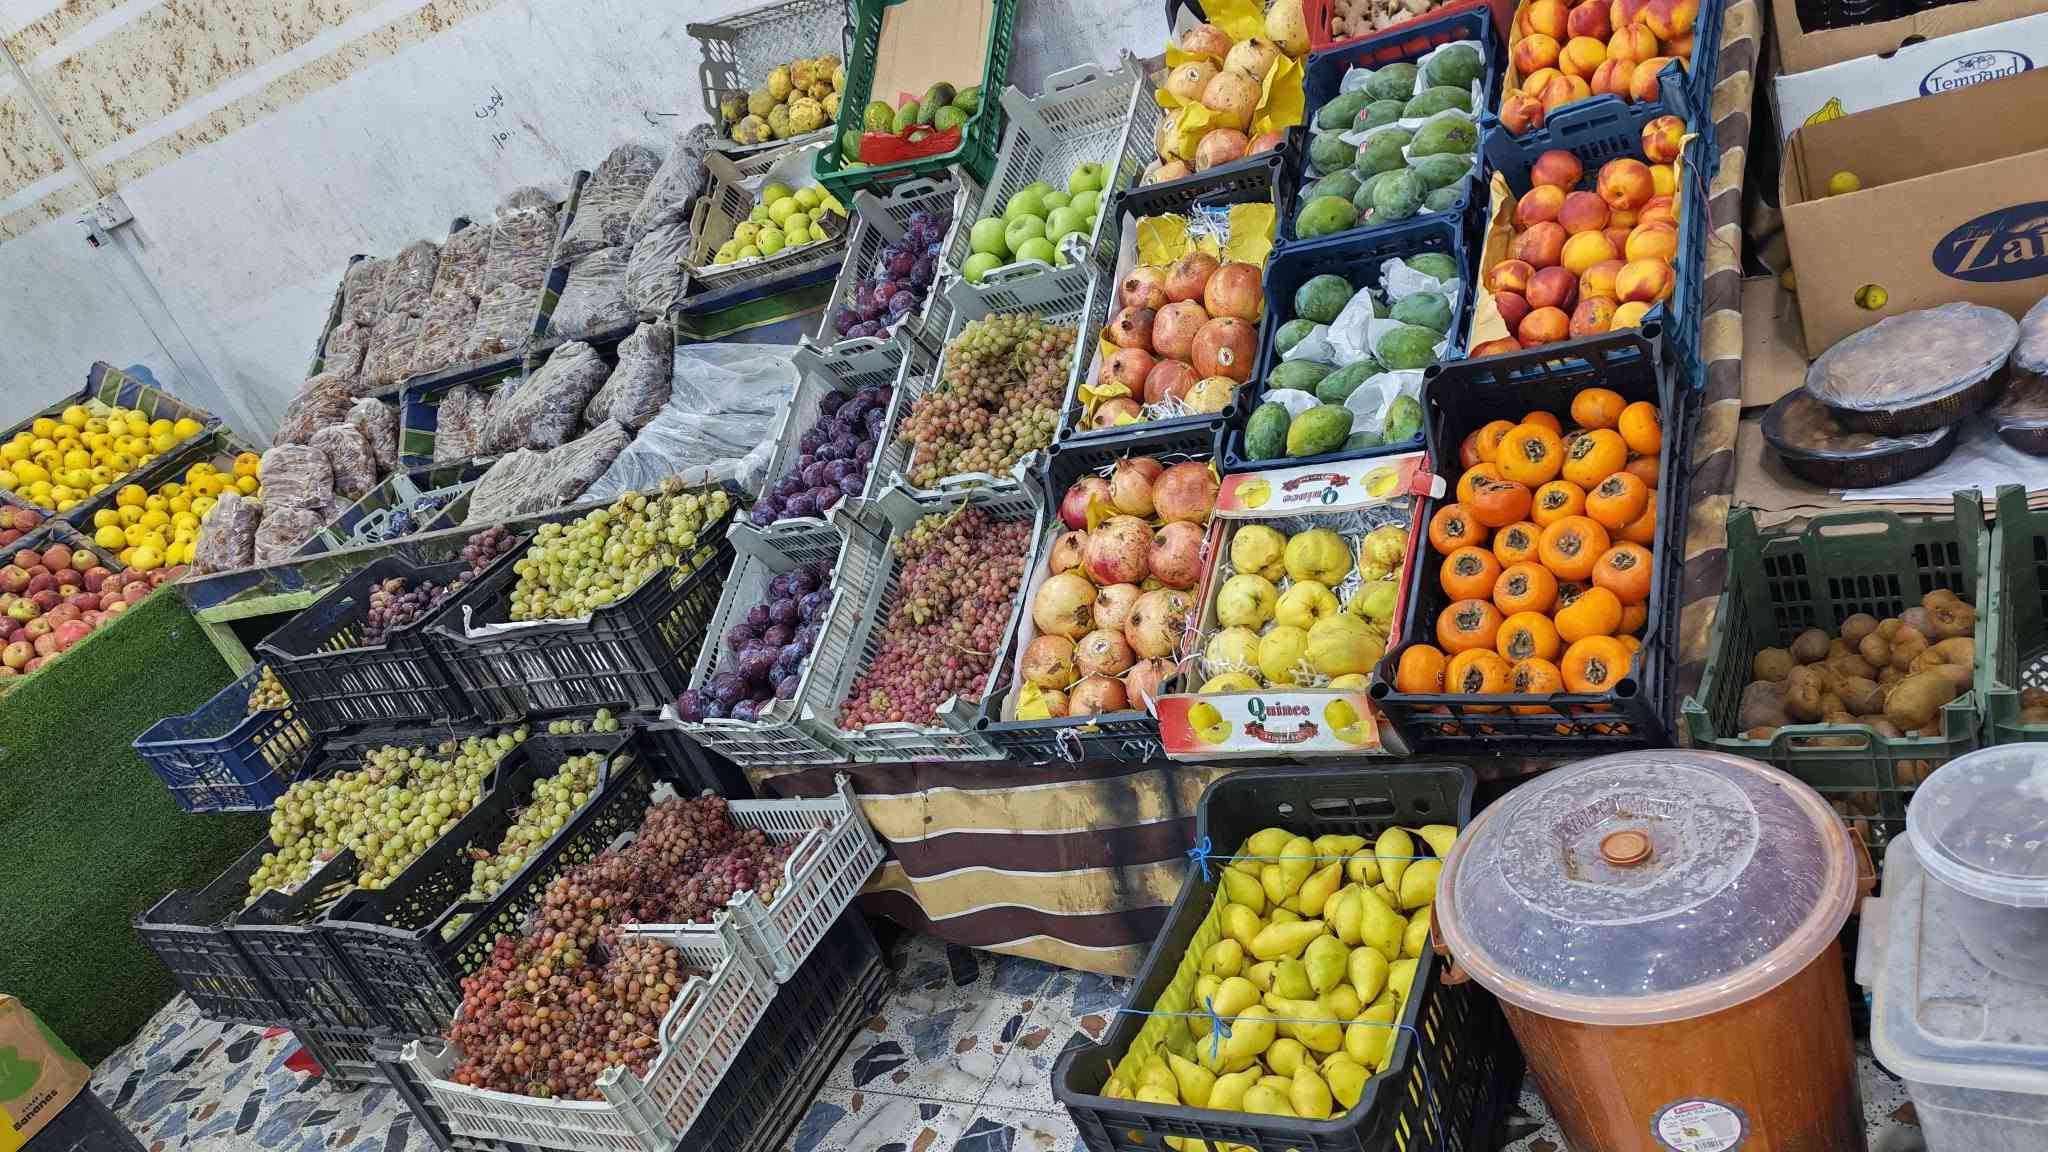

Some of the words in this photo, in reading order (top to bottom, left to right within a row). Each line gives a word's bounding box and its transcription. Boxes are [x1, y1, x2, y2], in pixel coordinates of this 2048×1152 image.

[1282, 486, 1340, 505] Quince
[1247, 697, 1311, 722] Quince
[13, 1089, 58, 1131] Bananas
